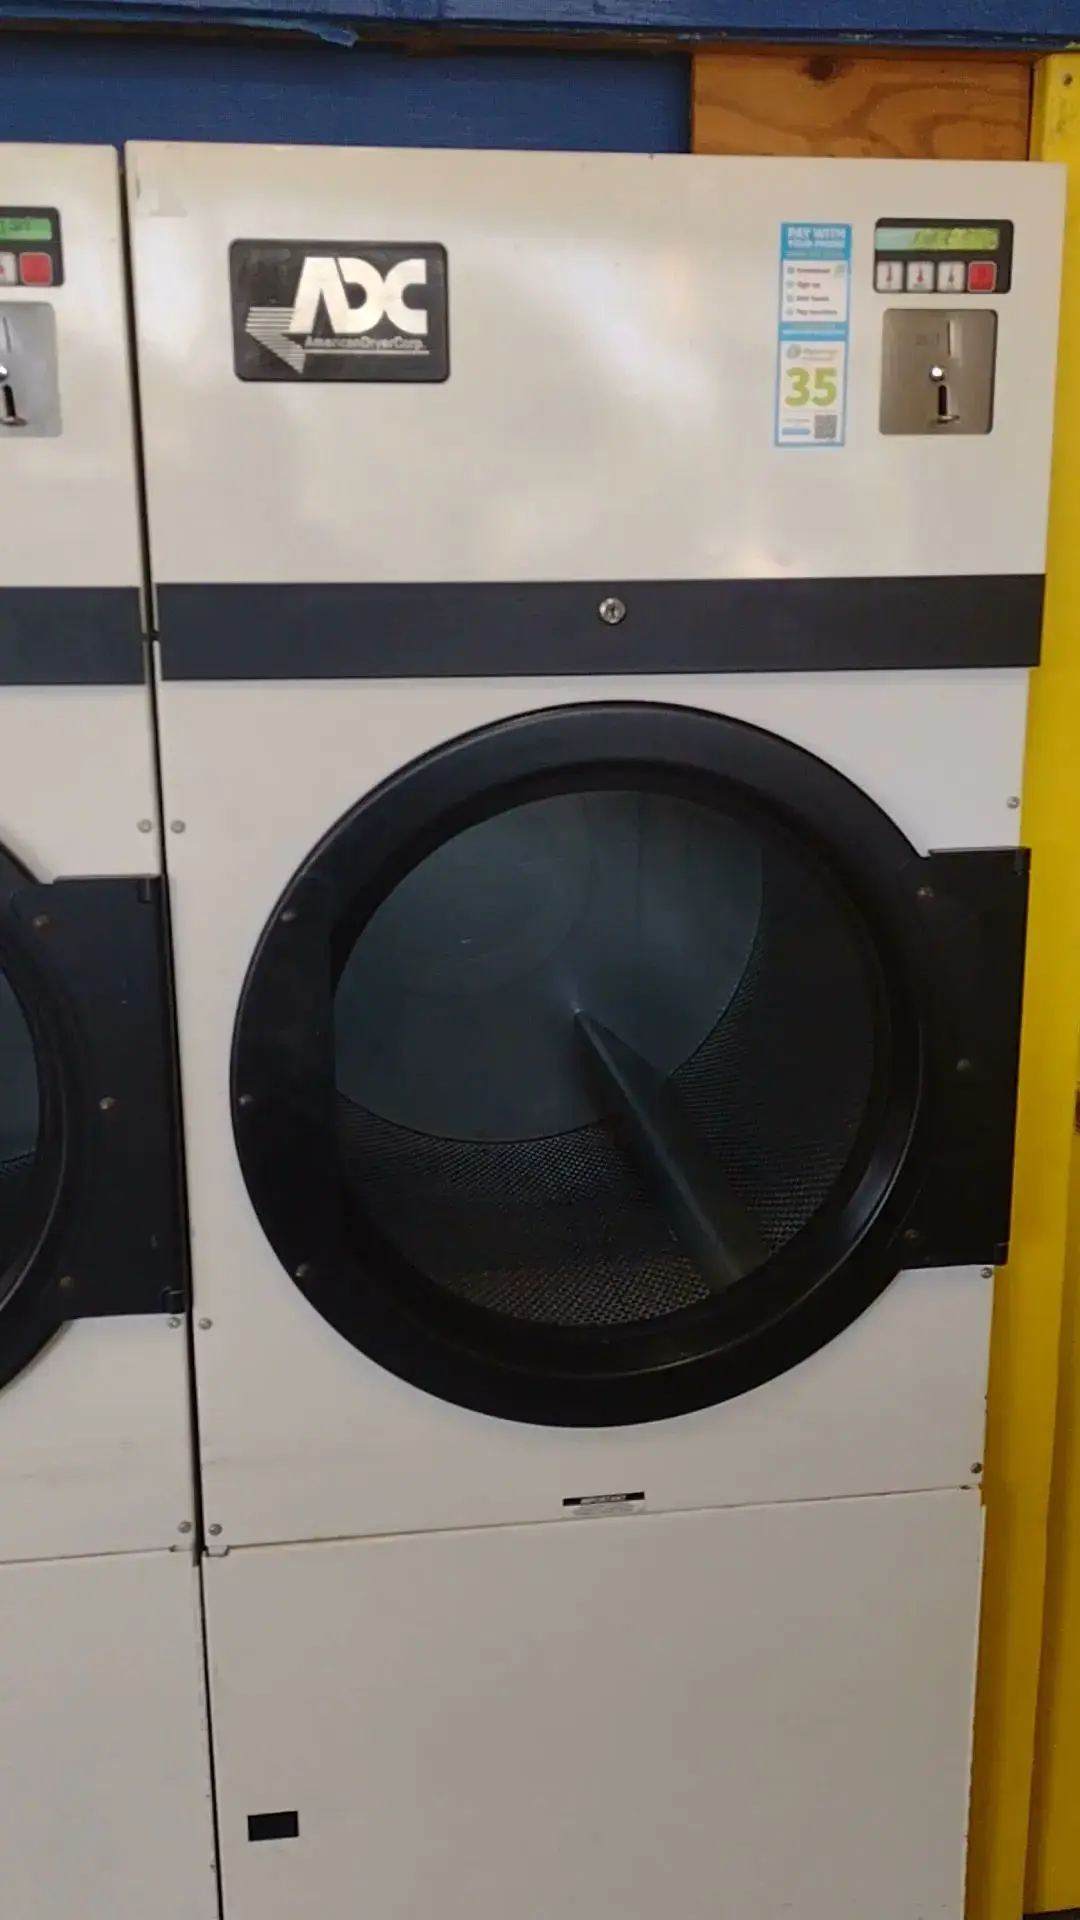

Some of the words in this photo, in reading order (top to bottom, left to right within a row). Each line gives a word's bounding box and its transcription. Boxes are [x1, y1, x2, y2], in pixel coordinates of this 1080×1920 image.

[787, 227, 812, 240] PAY
[813, 227, 846, 241] WITH
[289, 256, 428, 334] ADC
[784, 367, 837, 407] 35
